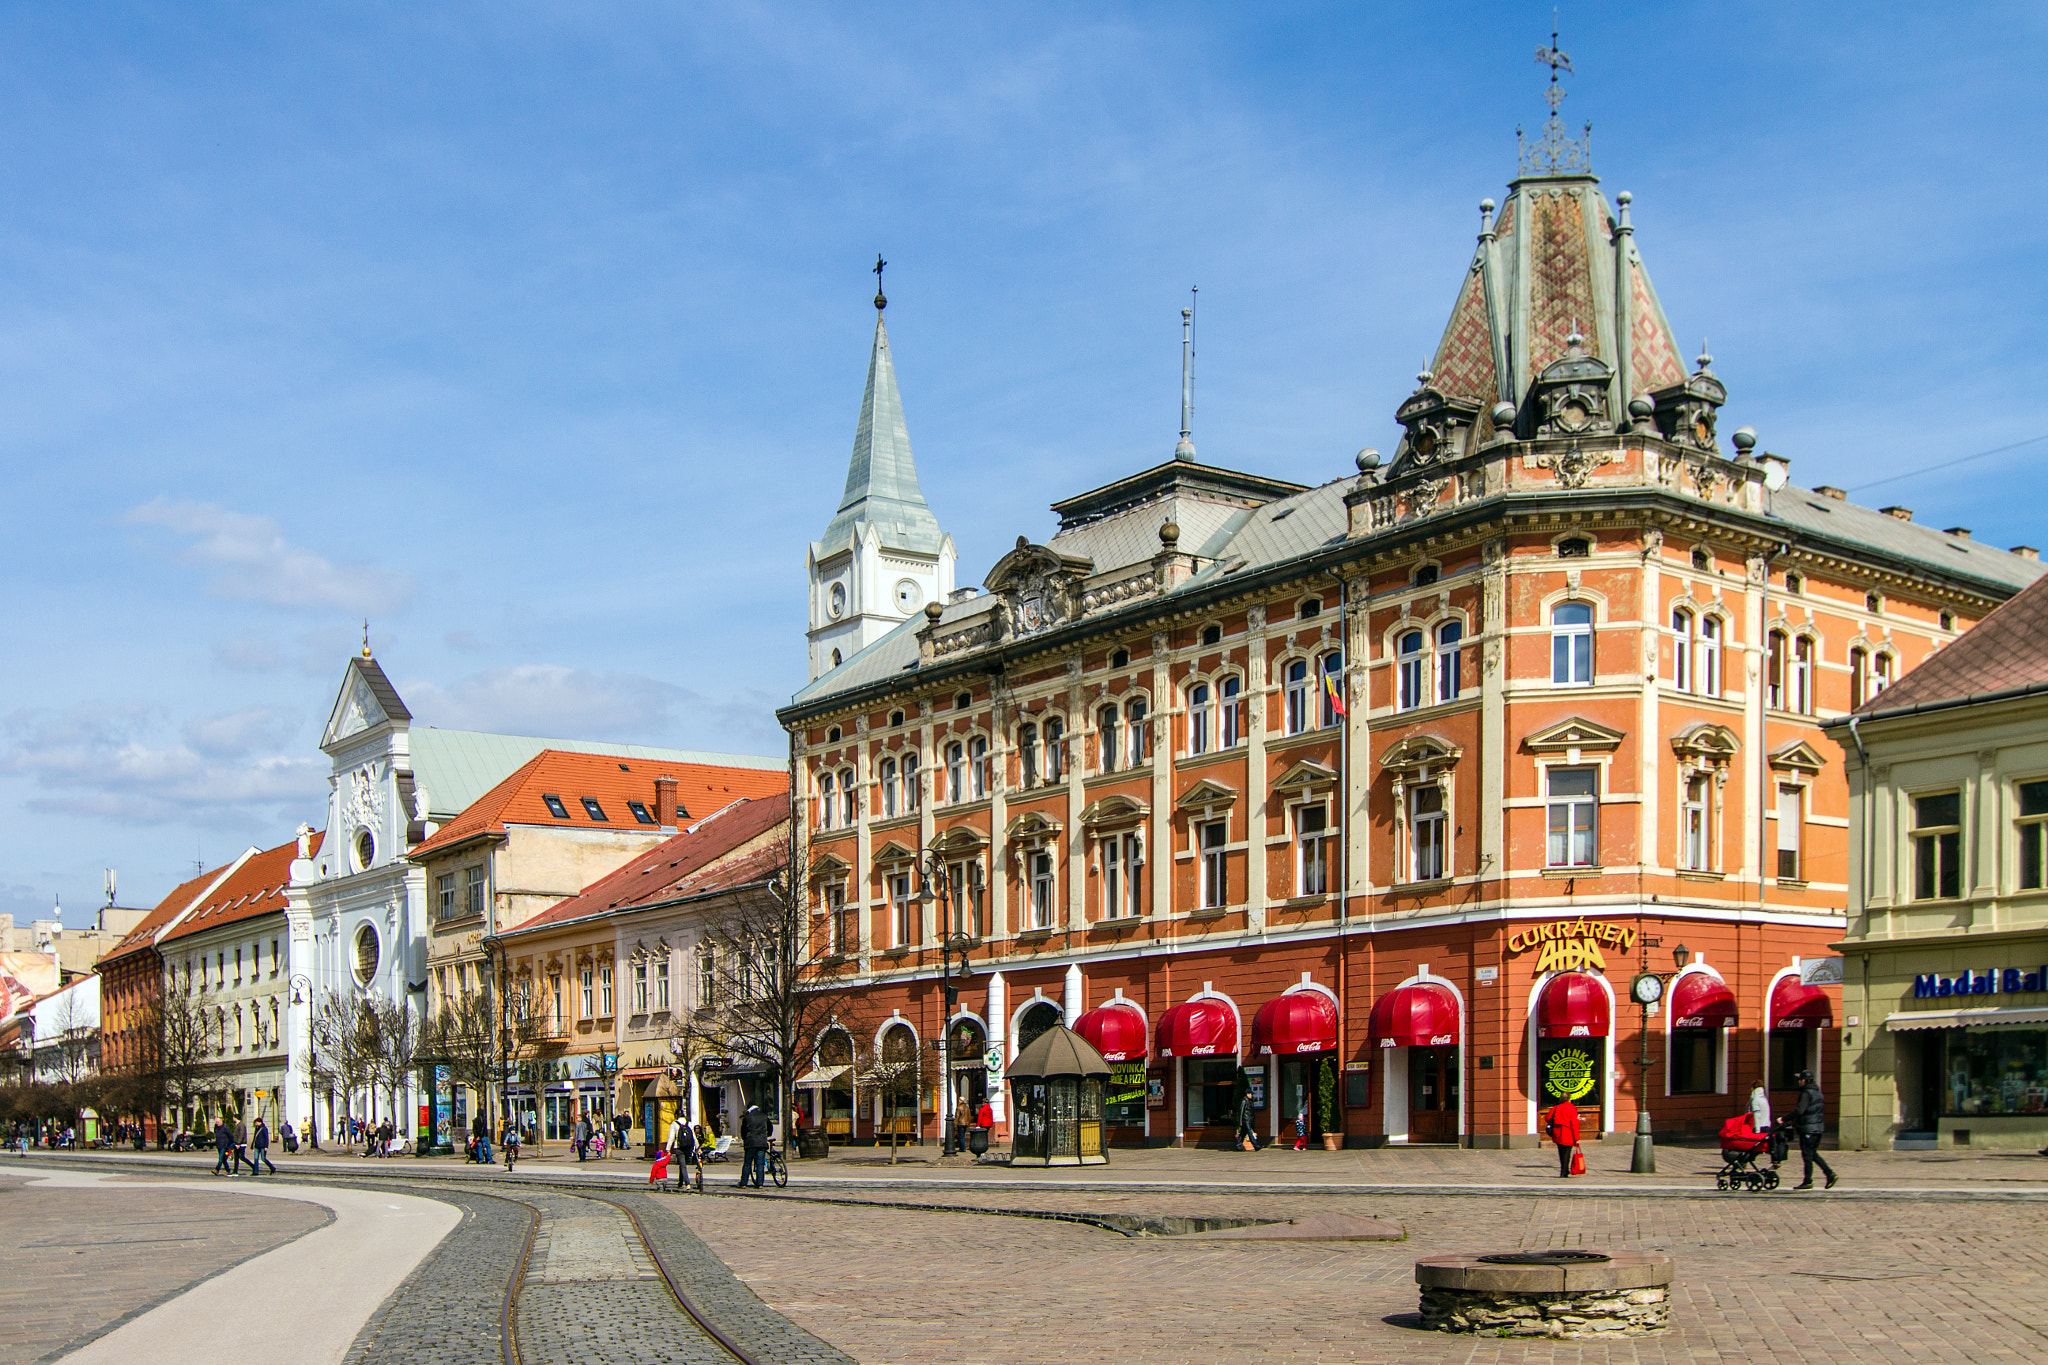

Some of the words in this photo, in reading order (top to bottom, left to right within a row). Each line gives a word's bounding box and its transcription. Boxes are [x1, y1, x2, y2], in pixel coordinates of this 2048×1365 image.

[1508, 916, 1637, 952] CUKRÁREŇ
[1535, 938, 1607, 972] AIDA
[1914, 968, 1998, 998] Madal
[2003, 965, 2048, 993] Bal
[1569, 1025, 1590, 1036] AIDA
[1545, 1048, 1595, 1069] NOVINKA
[1111, 1063, 1145, 1074] NOVINKA
[1124, 1074, 1129, 1084] A
[1129, 1073, 1145, 1084] PIZZA
[1545, 1081, 1555, 1092] OD
[1118, 1089, 1145, 1102] FEBRUÁRA
